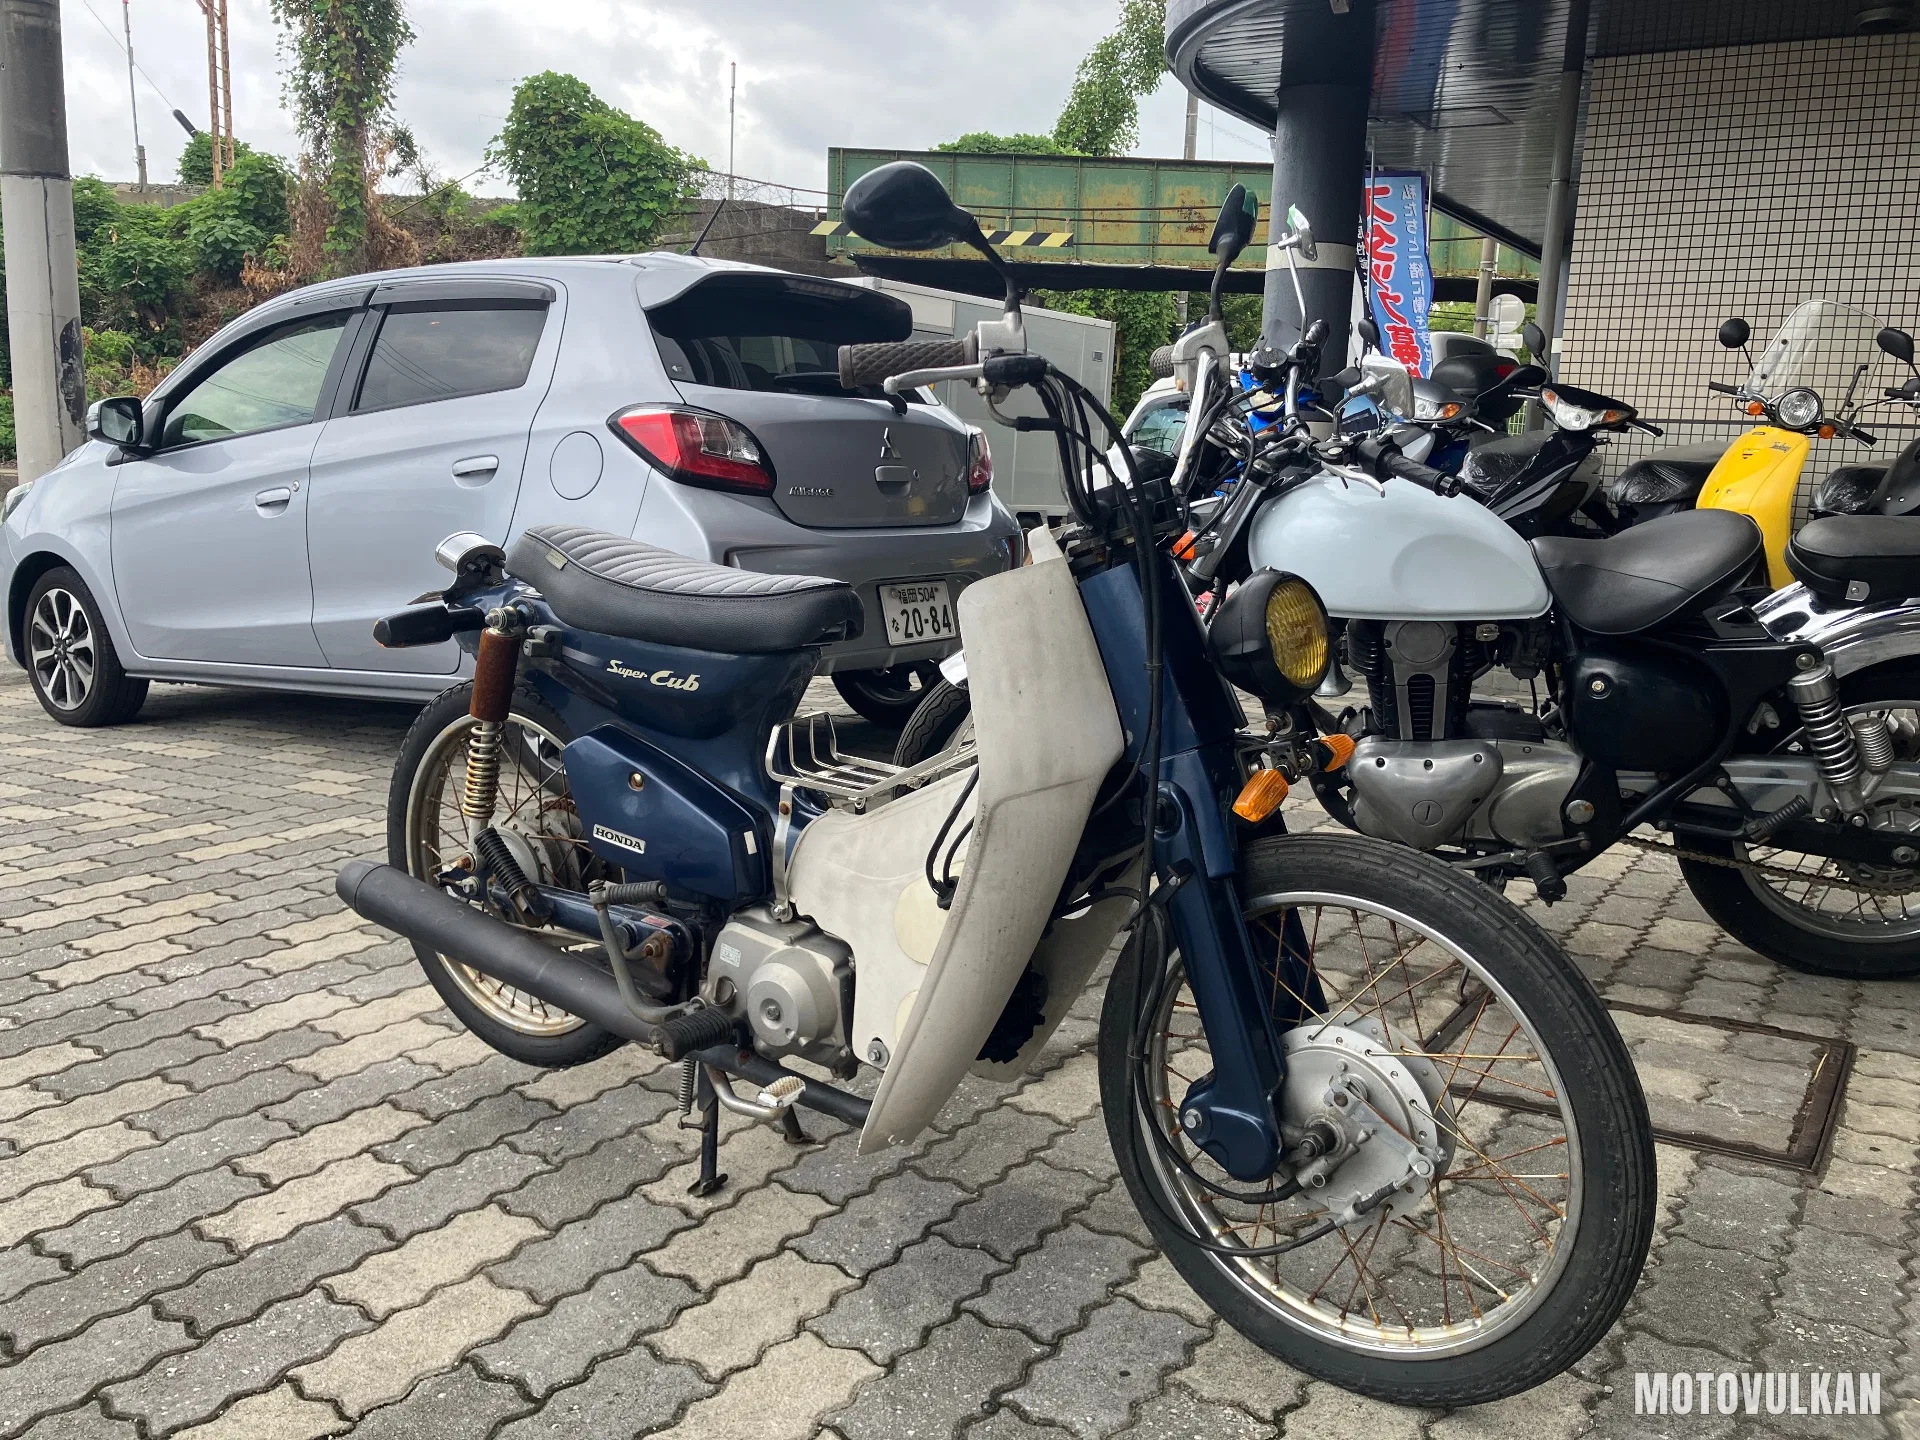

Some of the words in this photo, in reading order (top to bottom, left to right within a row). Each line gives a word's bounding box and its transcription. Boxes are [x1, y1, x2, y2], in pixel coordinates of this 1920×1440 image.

[900, 604, 952, 638] 20-84
[607, 659, 648, 679] Super
[650, 670, 700, 691] Cub
[595, 827, 643, 851] HONDA
